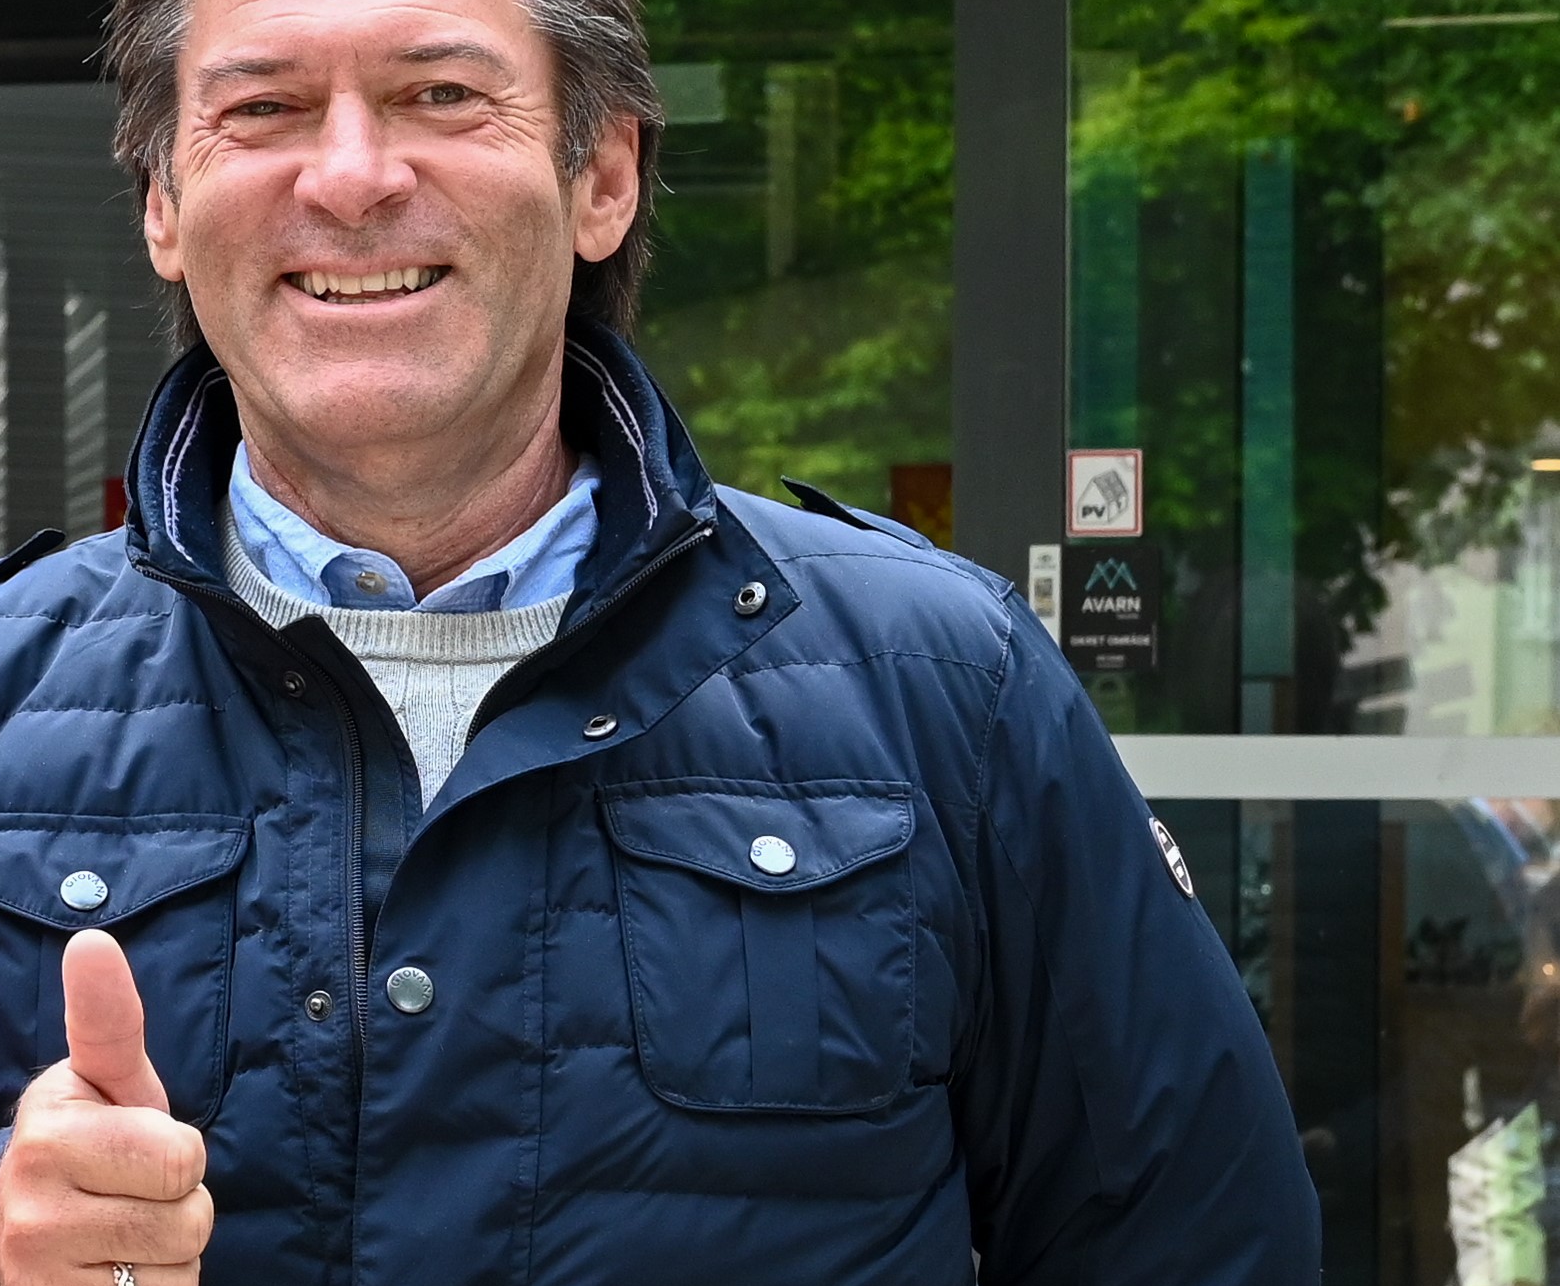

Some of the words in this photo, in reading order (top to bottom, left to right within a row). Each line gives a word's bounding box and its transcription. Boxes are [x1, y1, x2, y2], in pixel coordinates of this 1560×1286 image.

[1081, 505, 1106, 519] PV
[1081, 596, 1142, 613] AVARN
[65, 873, 105, 899] GIOVANI
[391, 969, 432, 1000] GIOVANI
